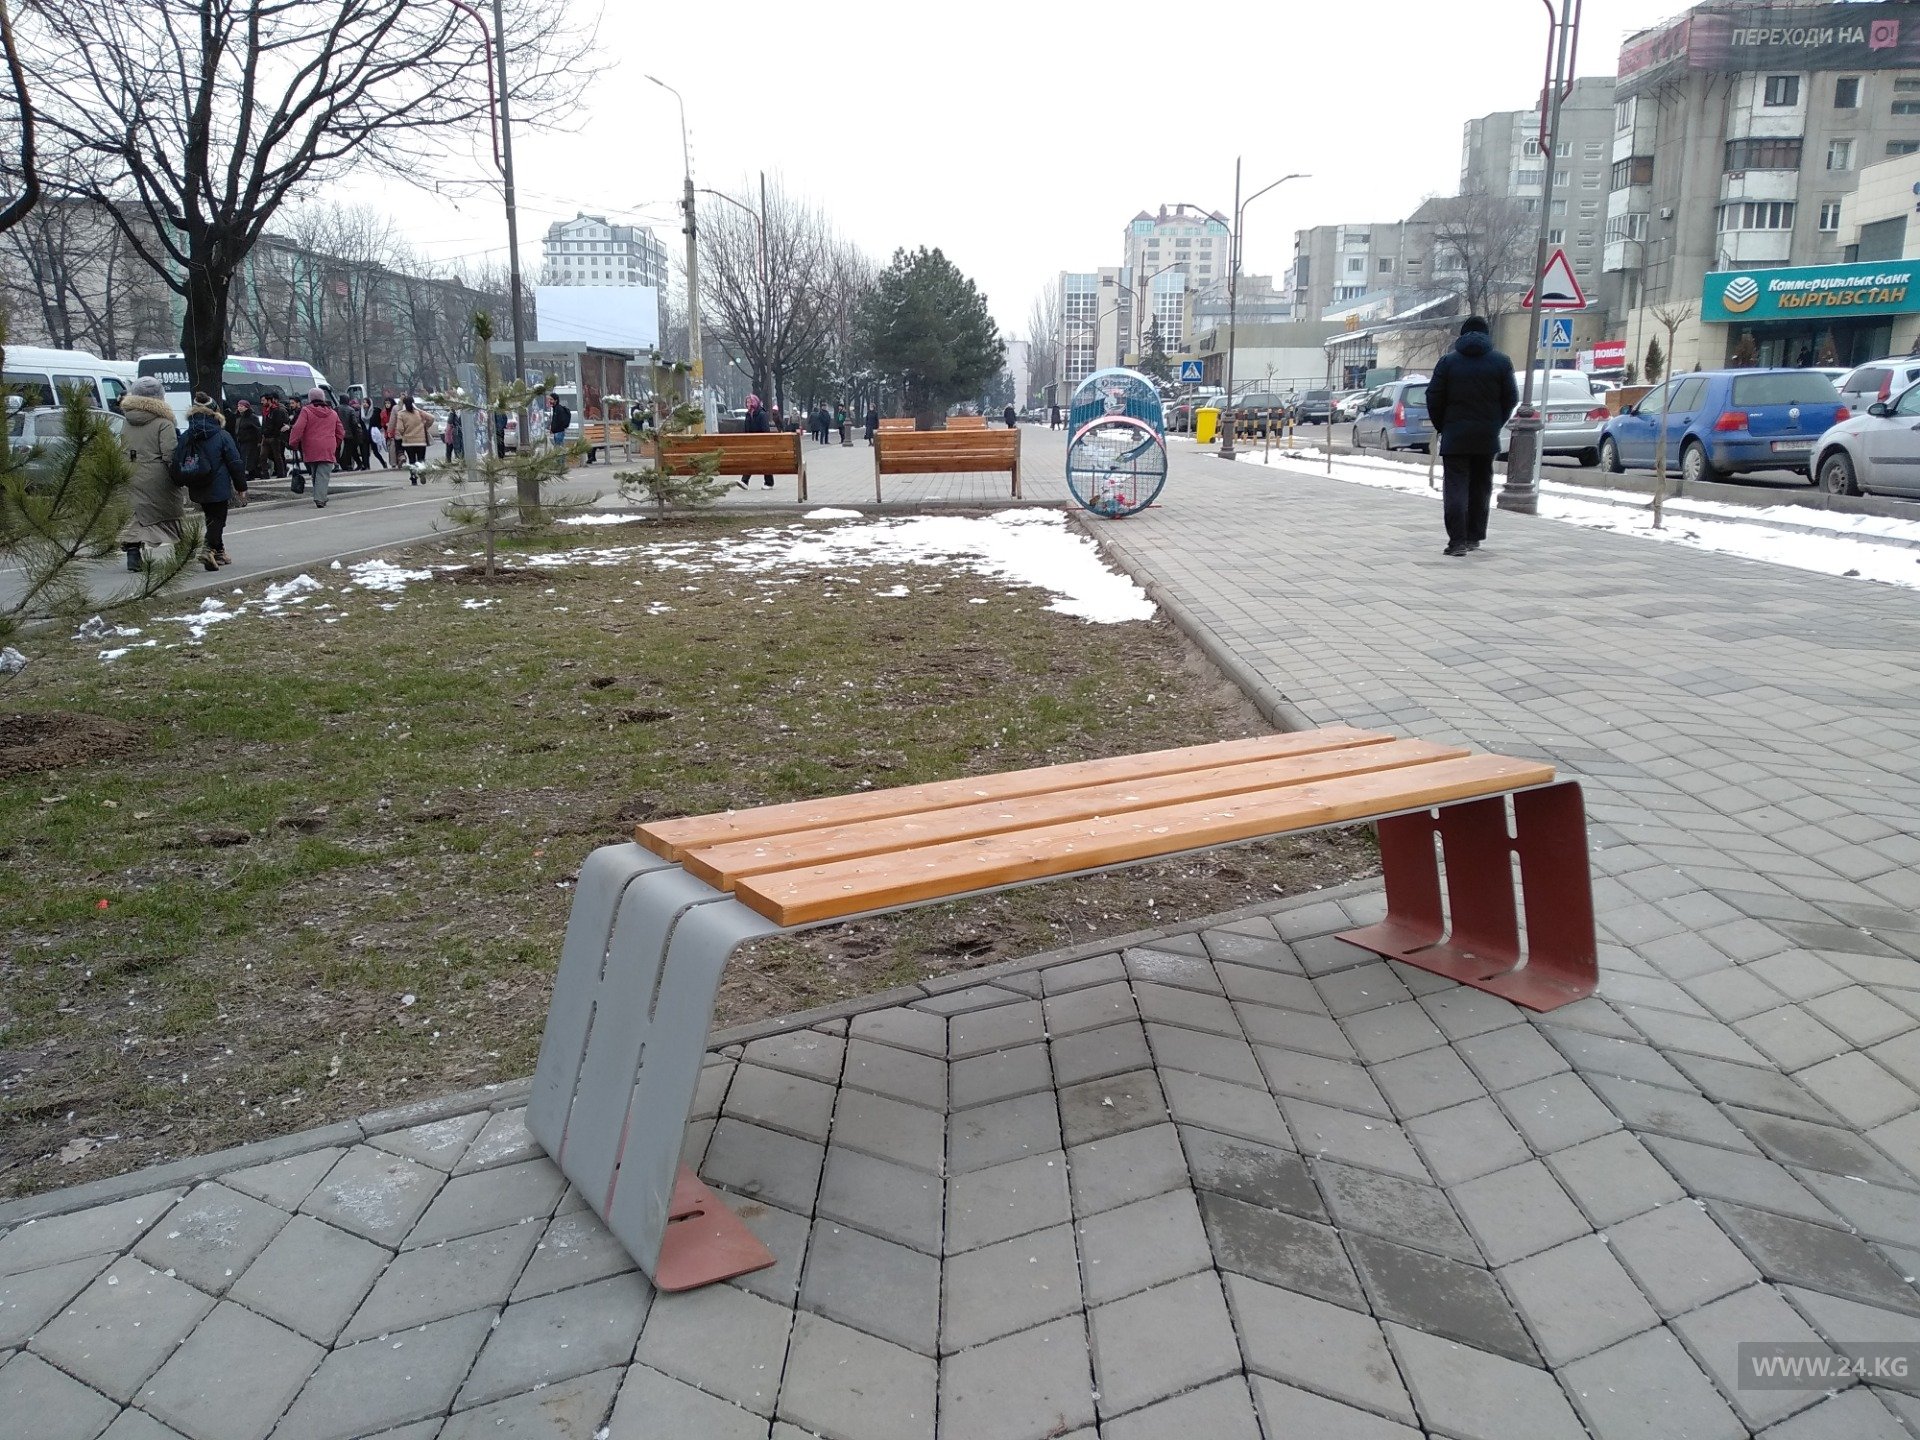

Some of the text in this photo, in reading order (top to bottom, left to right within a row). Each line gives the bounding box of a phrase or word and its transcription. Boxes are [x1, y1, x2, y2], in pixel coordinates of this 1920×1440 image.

[1731, 28, 1833, 48] ПЕРЕХОДИ
[1839, 27, 1865, 43] НА
[1875, 273, 1911, 285] банк
[1778, 287, 1907, 308] КЫРГЫЗСТАН
[1594, 348, 1626, 359] ЛОМБА
